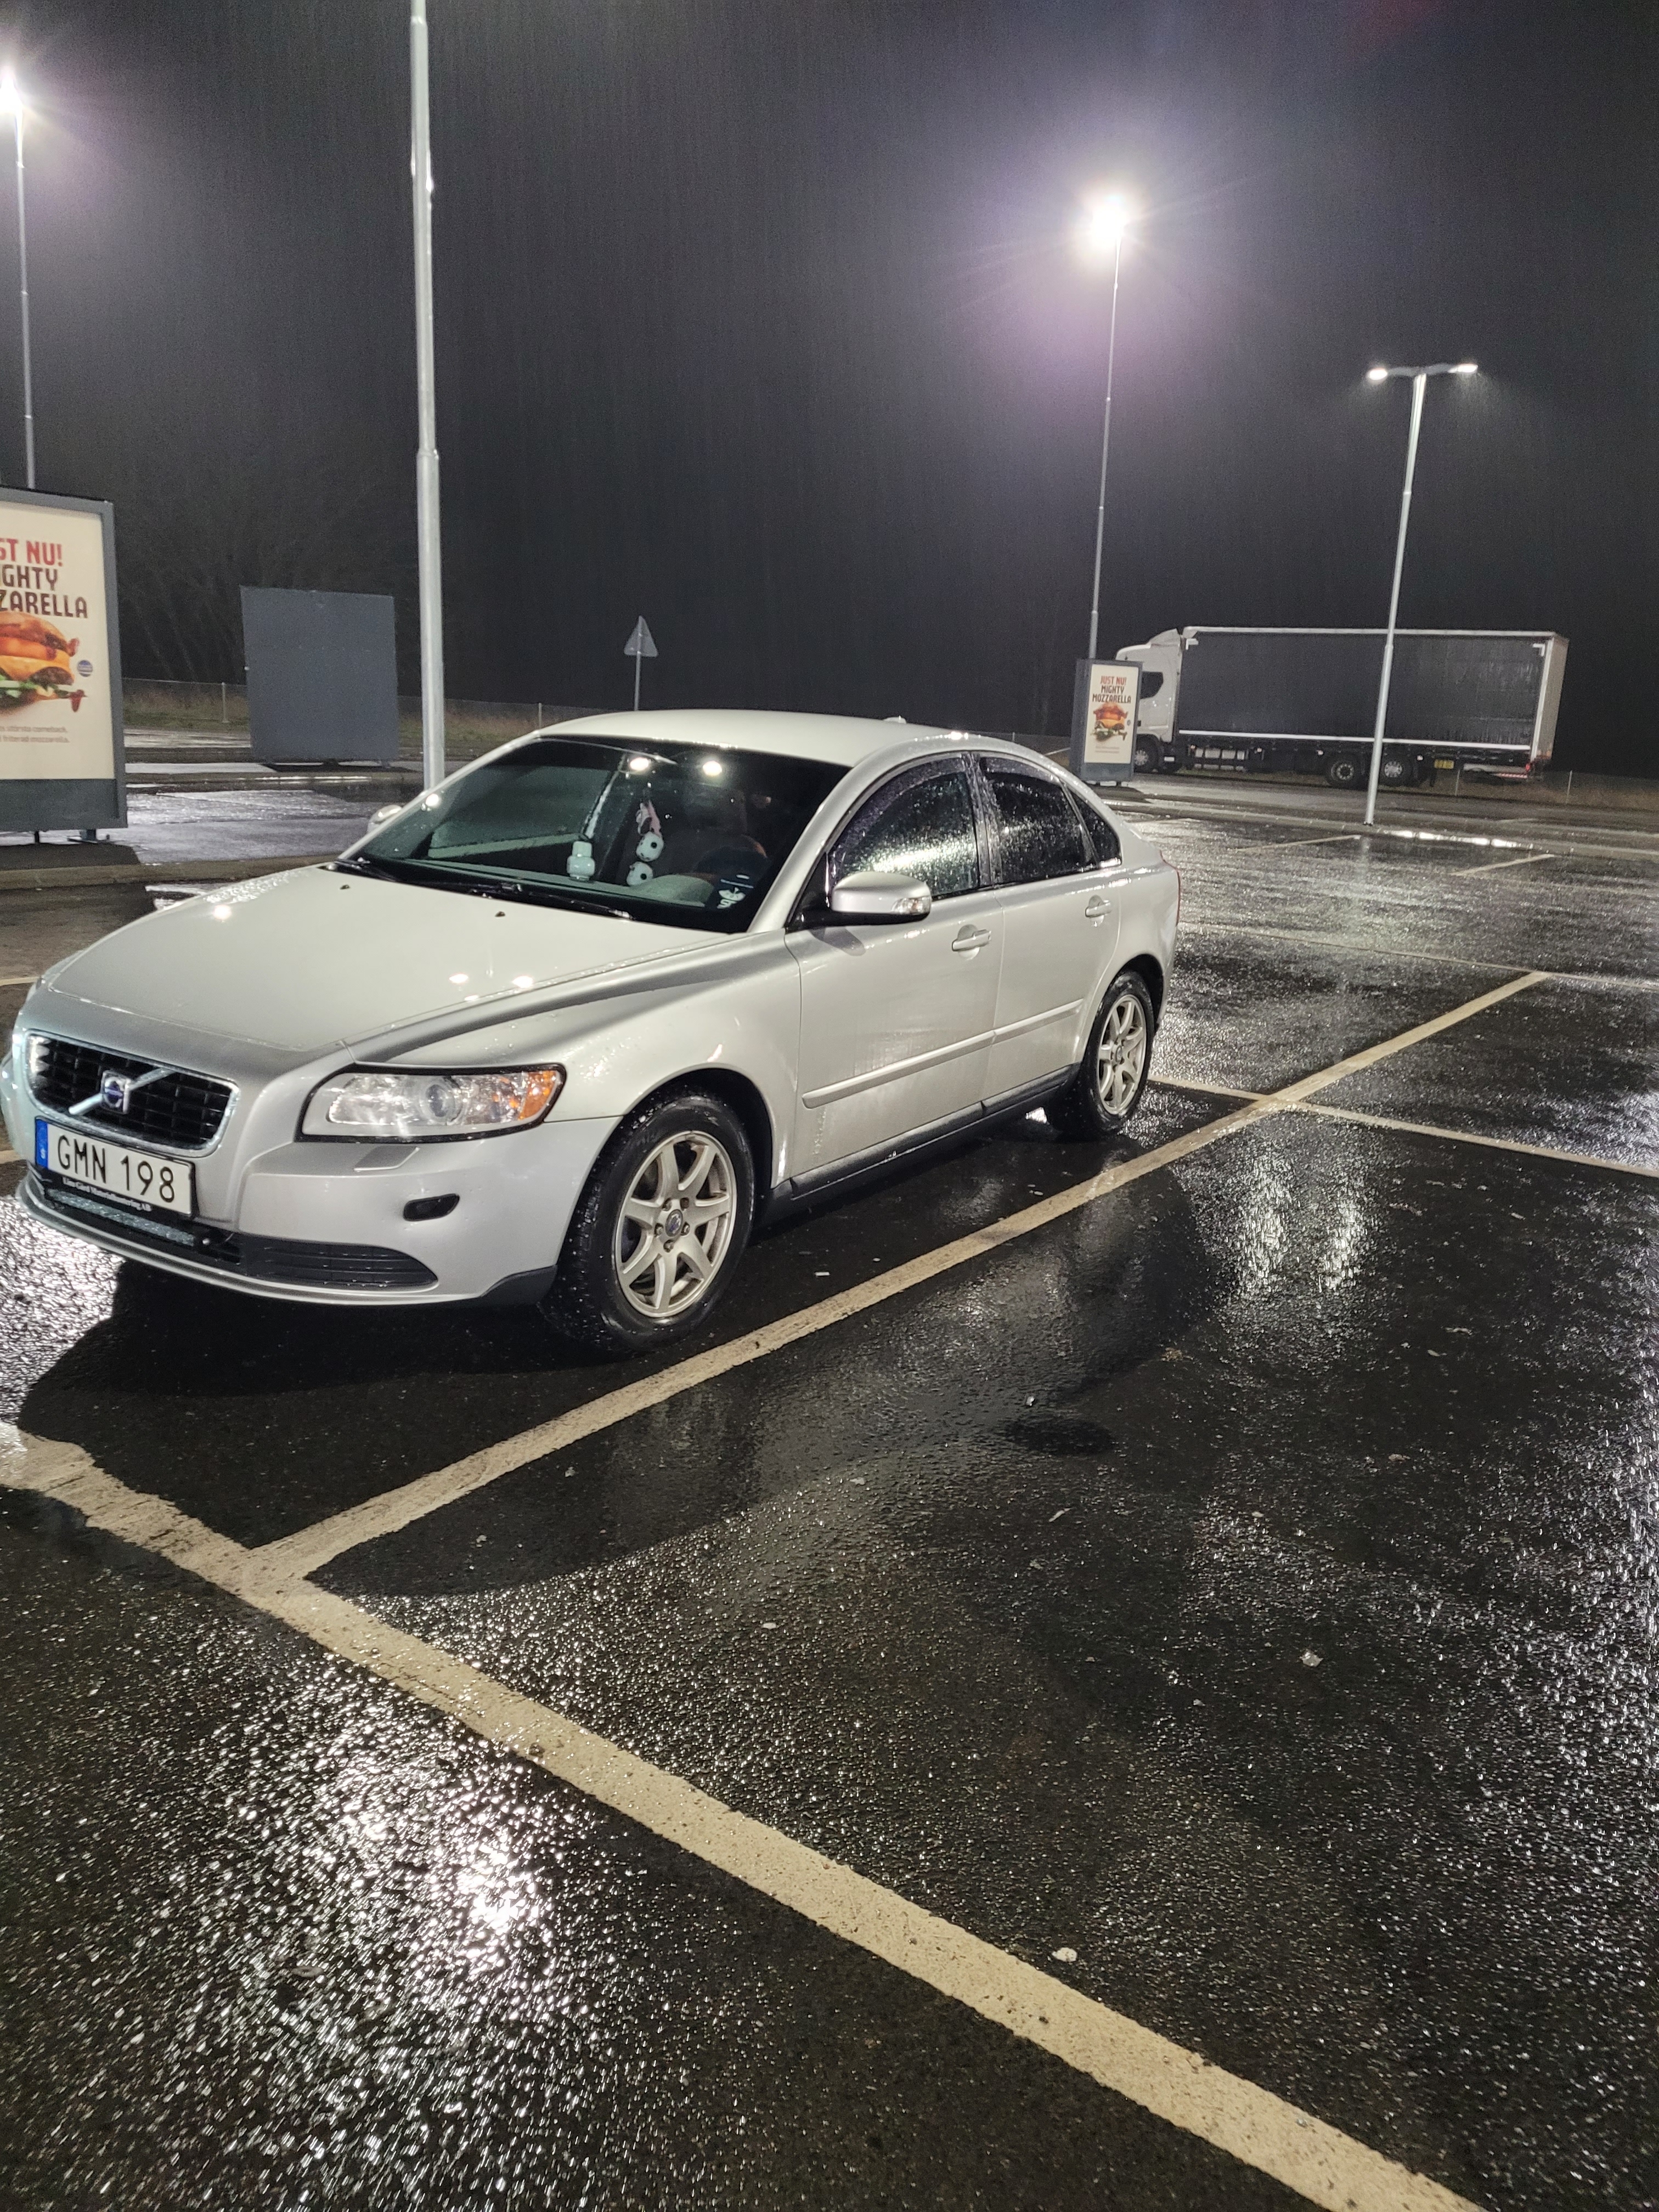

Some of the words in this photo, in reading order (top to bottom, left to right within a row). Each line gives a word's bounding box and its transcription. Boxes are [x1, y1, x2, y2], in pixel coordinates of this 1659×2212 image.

[26, 540, 63, 567] NU!
[2, 564, 58, 591] GHTY
[1101, 676, 1114, 684] JUST
[1116, 676, 1127, 685] NU!
[1101, 685, 1124, 694] MIGHTY
[1092, 693, 1131, 703] MOZZARELLA
[58, 1135, 106, 1184] GMN
[121, 1155, 174, 1203] 198
